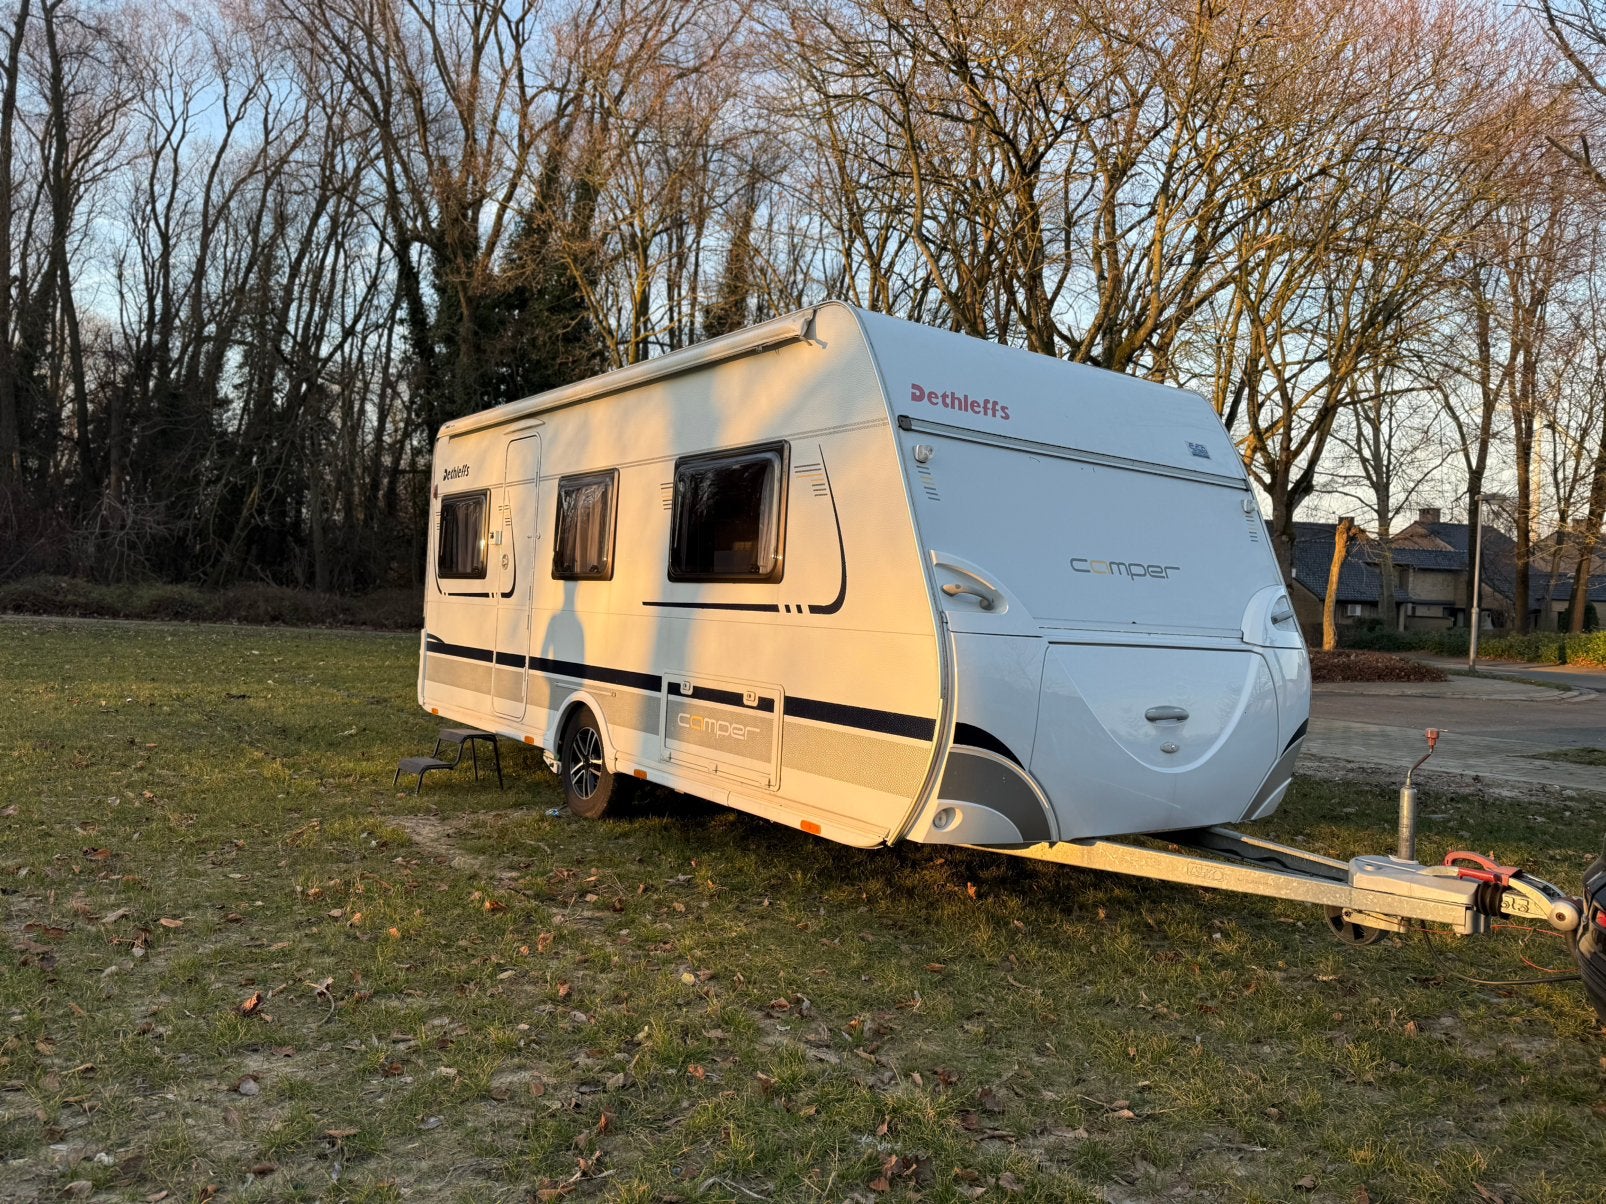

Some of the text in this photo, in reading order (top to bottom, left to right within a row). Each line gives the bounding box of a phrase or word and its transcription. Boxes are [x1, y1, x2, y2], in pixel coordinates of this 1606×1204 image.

[911, 383, 1010, 420] Dethleffs
[1070, 558, 1180, 581] camper
[678, 713, 760, 740] camper
